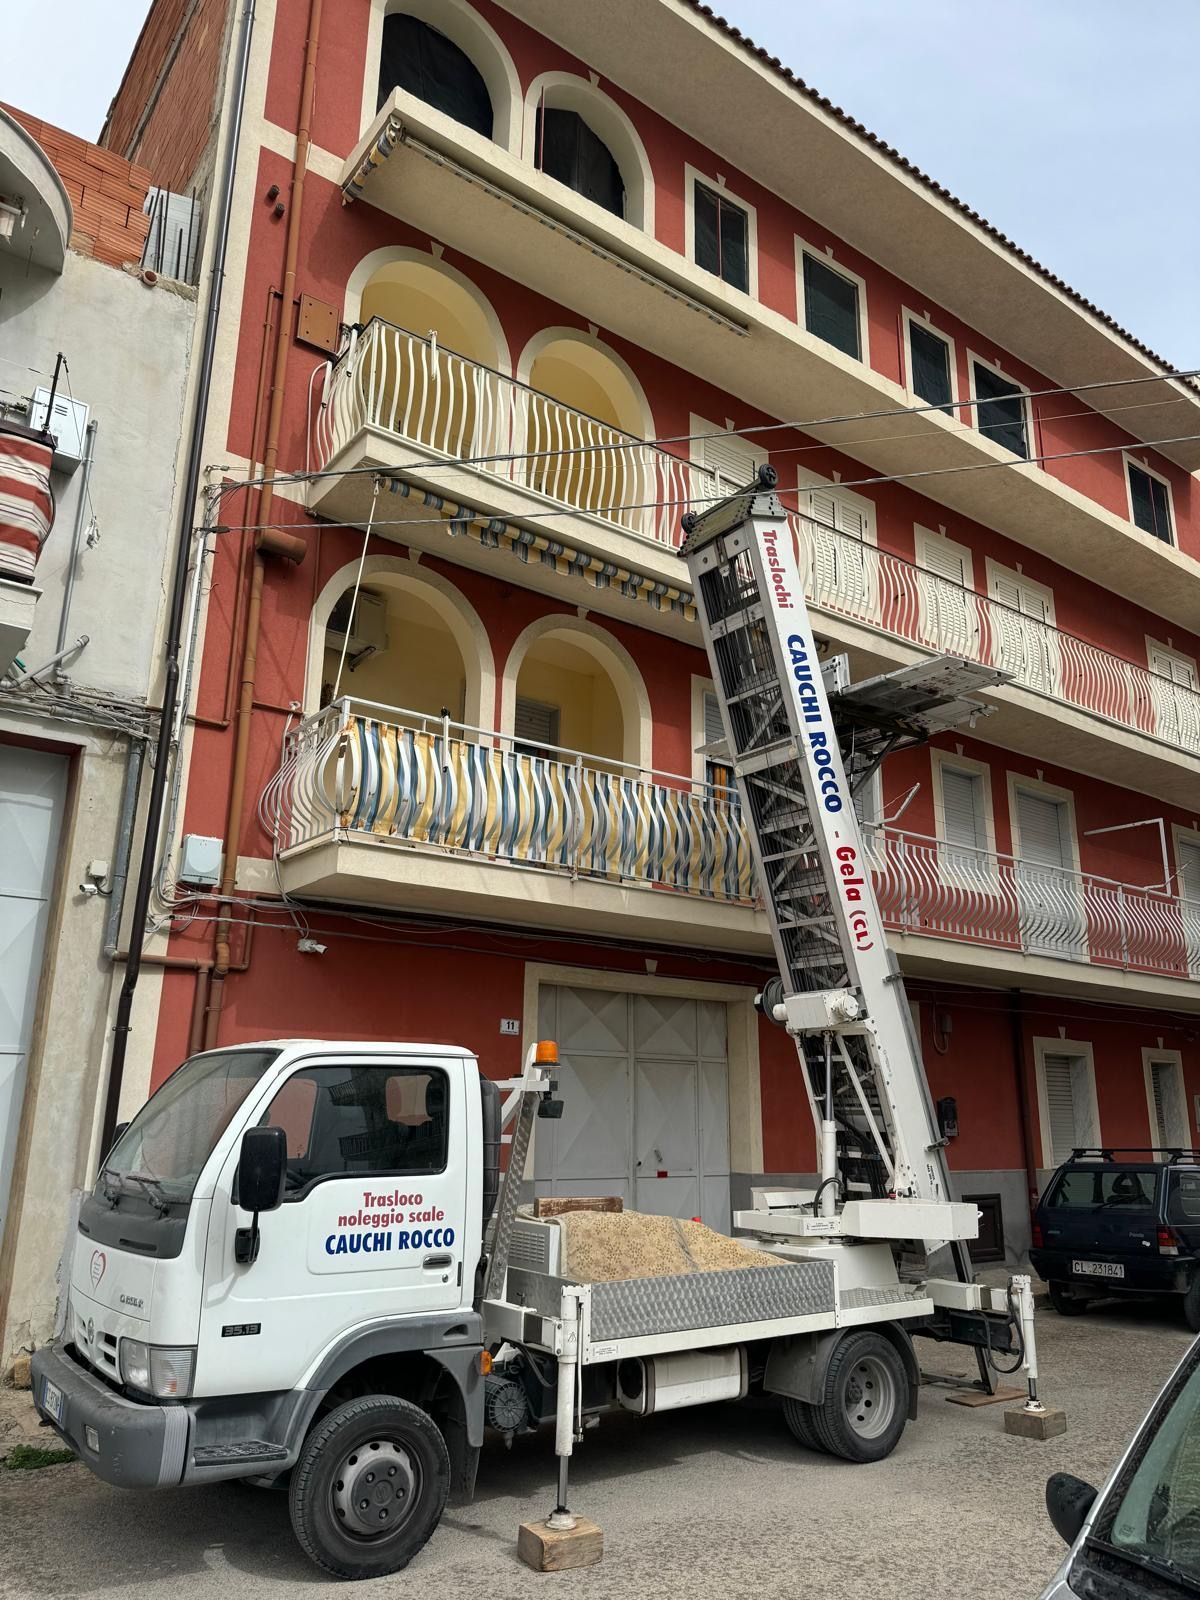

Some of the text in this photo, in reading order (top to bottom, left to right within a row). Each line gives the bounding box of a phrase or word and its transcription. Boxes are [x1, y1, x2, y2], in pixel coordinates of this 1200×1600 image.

[762, 529, 874, 951] Traslochi CAUCHI ROCCO - Gela (CL)
[506, 1021, 515, 1031] 11
[363, 1189, 423, 1207] Trasloco
[338, 1205, 445, 1228] noleggio scale
[325, 1227, 455, 1255] CAUCHI ROCCO
[1074, 1261, 1123, 1277] CL 231841
[224, 1324, 259, 1336] 35.13
